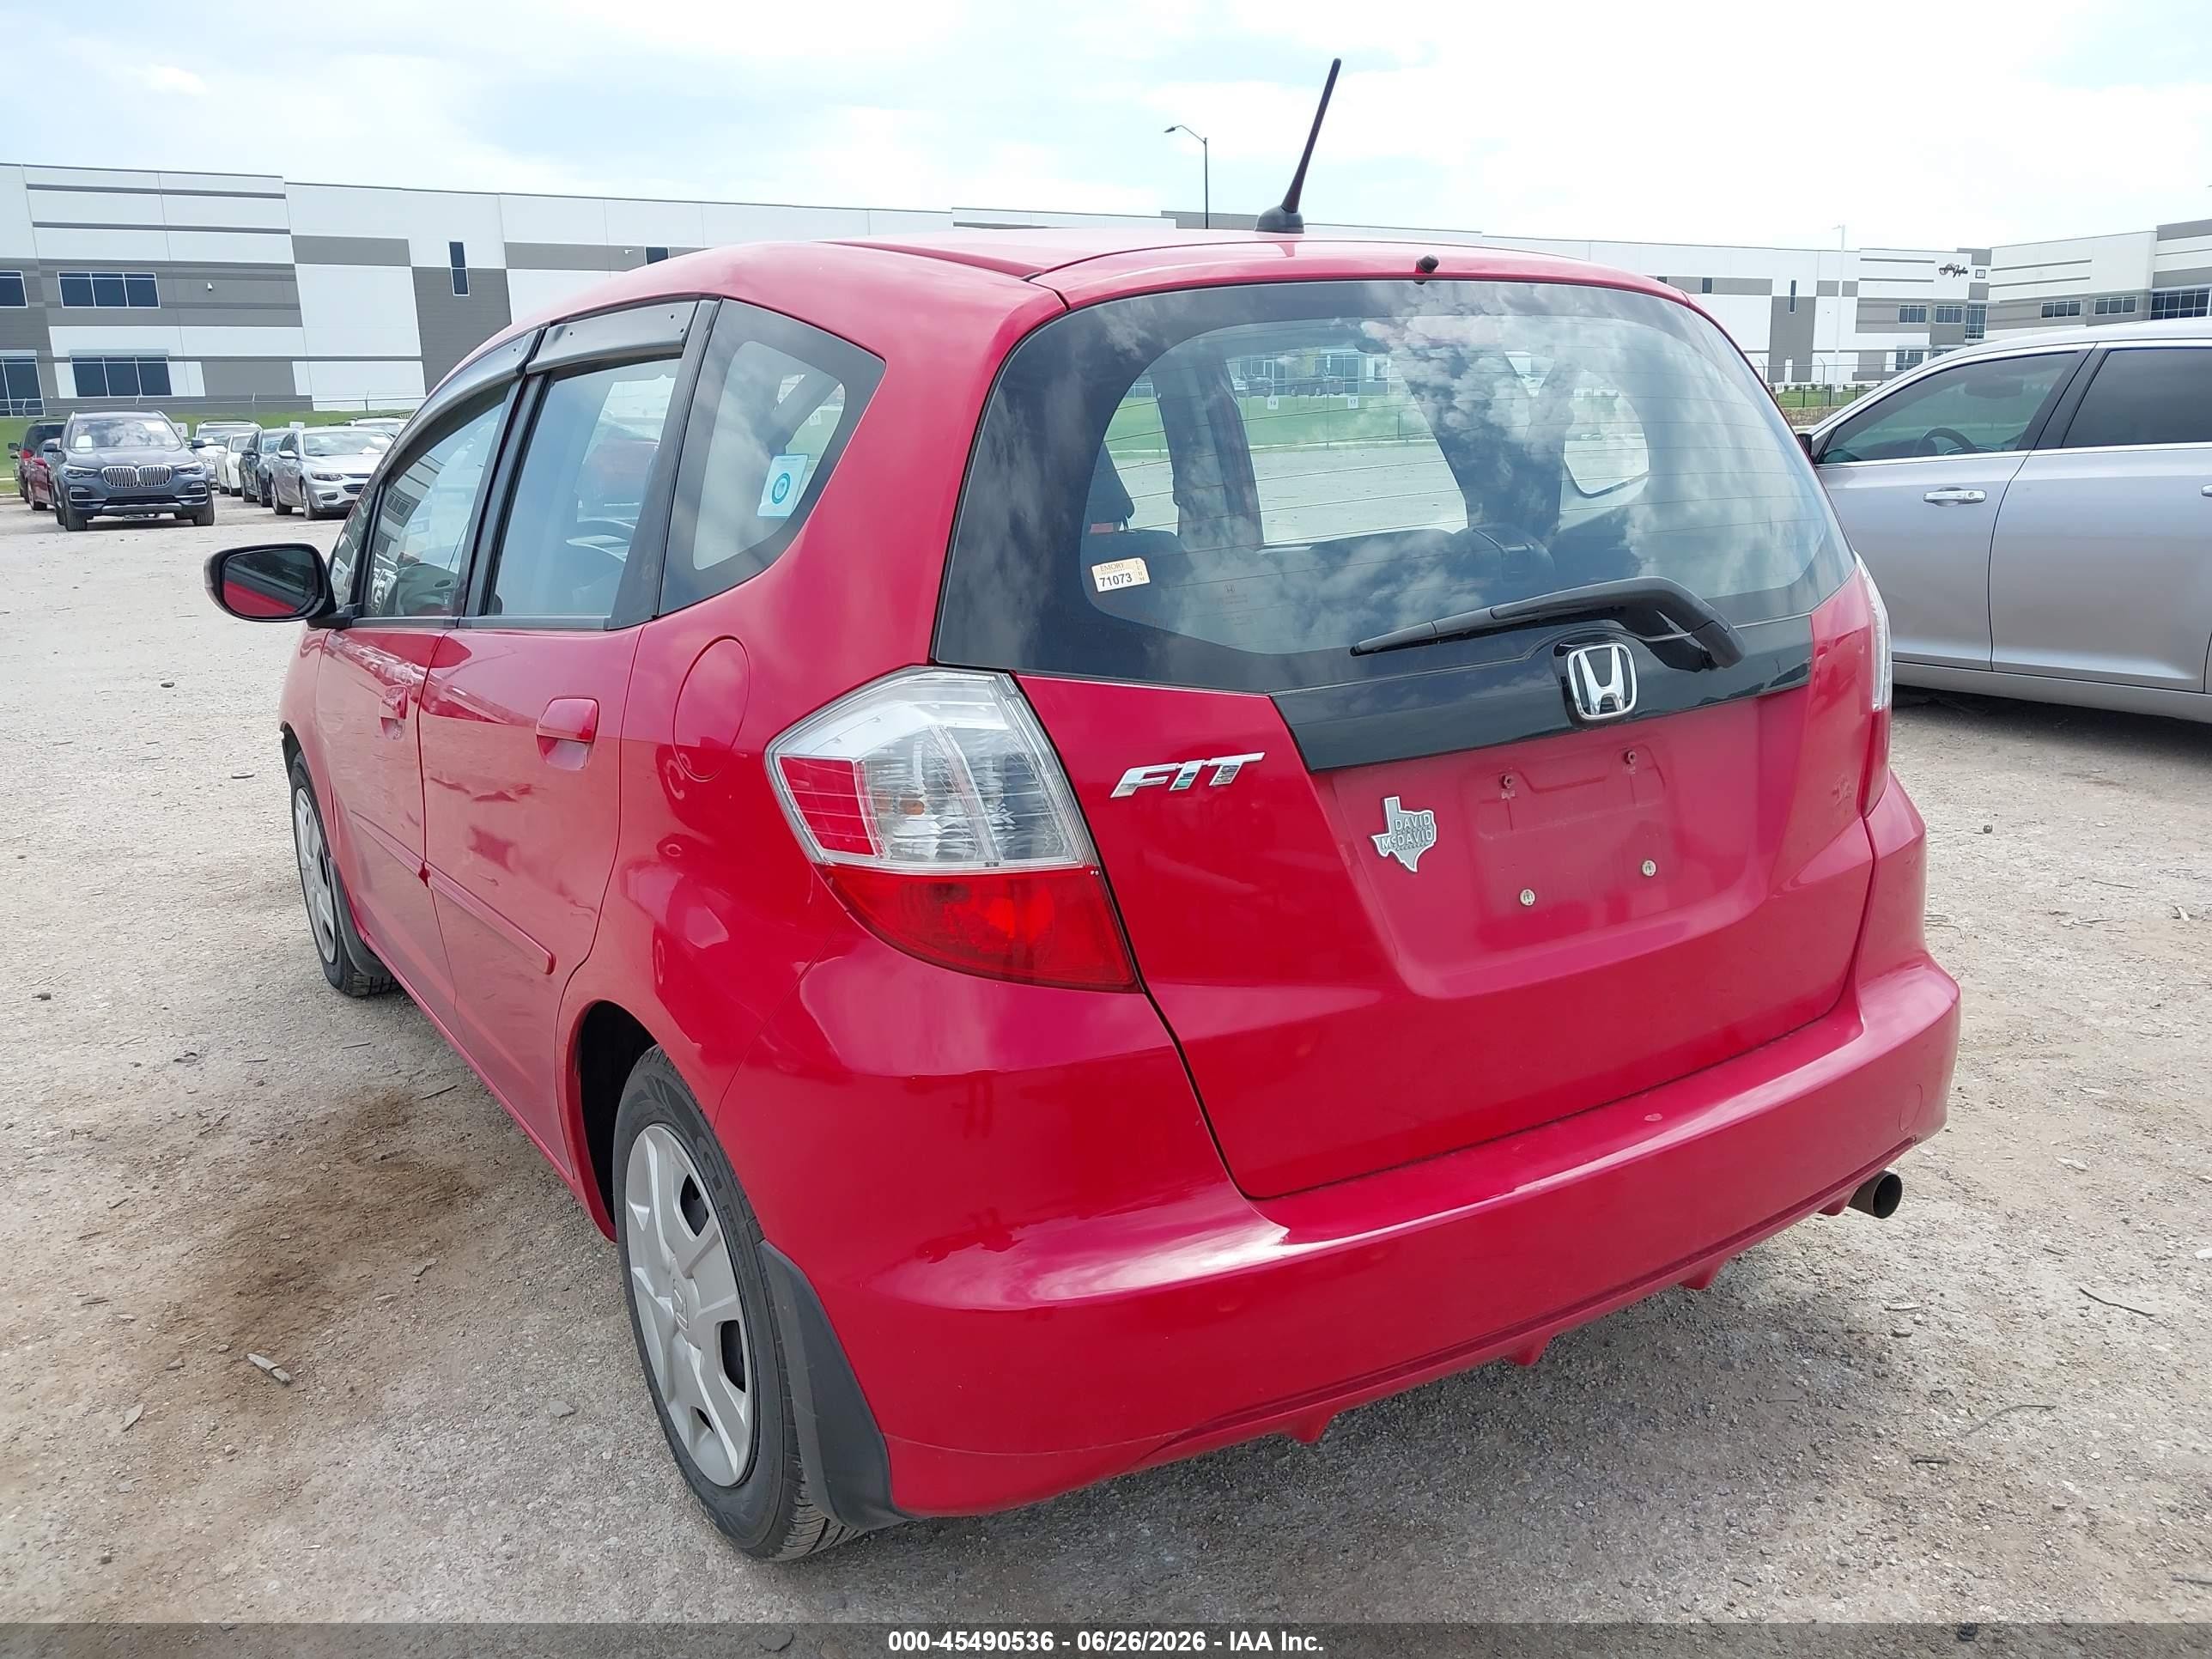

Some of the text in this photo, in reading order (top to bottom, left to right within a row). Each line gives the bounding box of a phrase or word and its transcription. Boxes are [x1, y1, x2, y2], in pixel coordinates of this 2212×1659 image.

[1100, 562, 1125, 572] EMORY
[1099, 573, 1133, 587] 71073
[1110, 751, 1266, 798] FIT
[1395, 814, 1431, 831] DAVID
[1381, 830, 1433, 850] McDAVID
